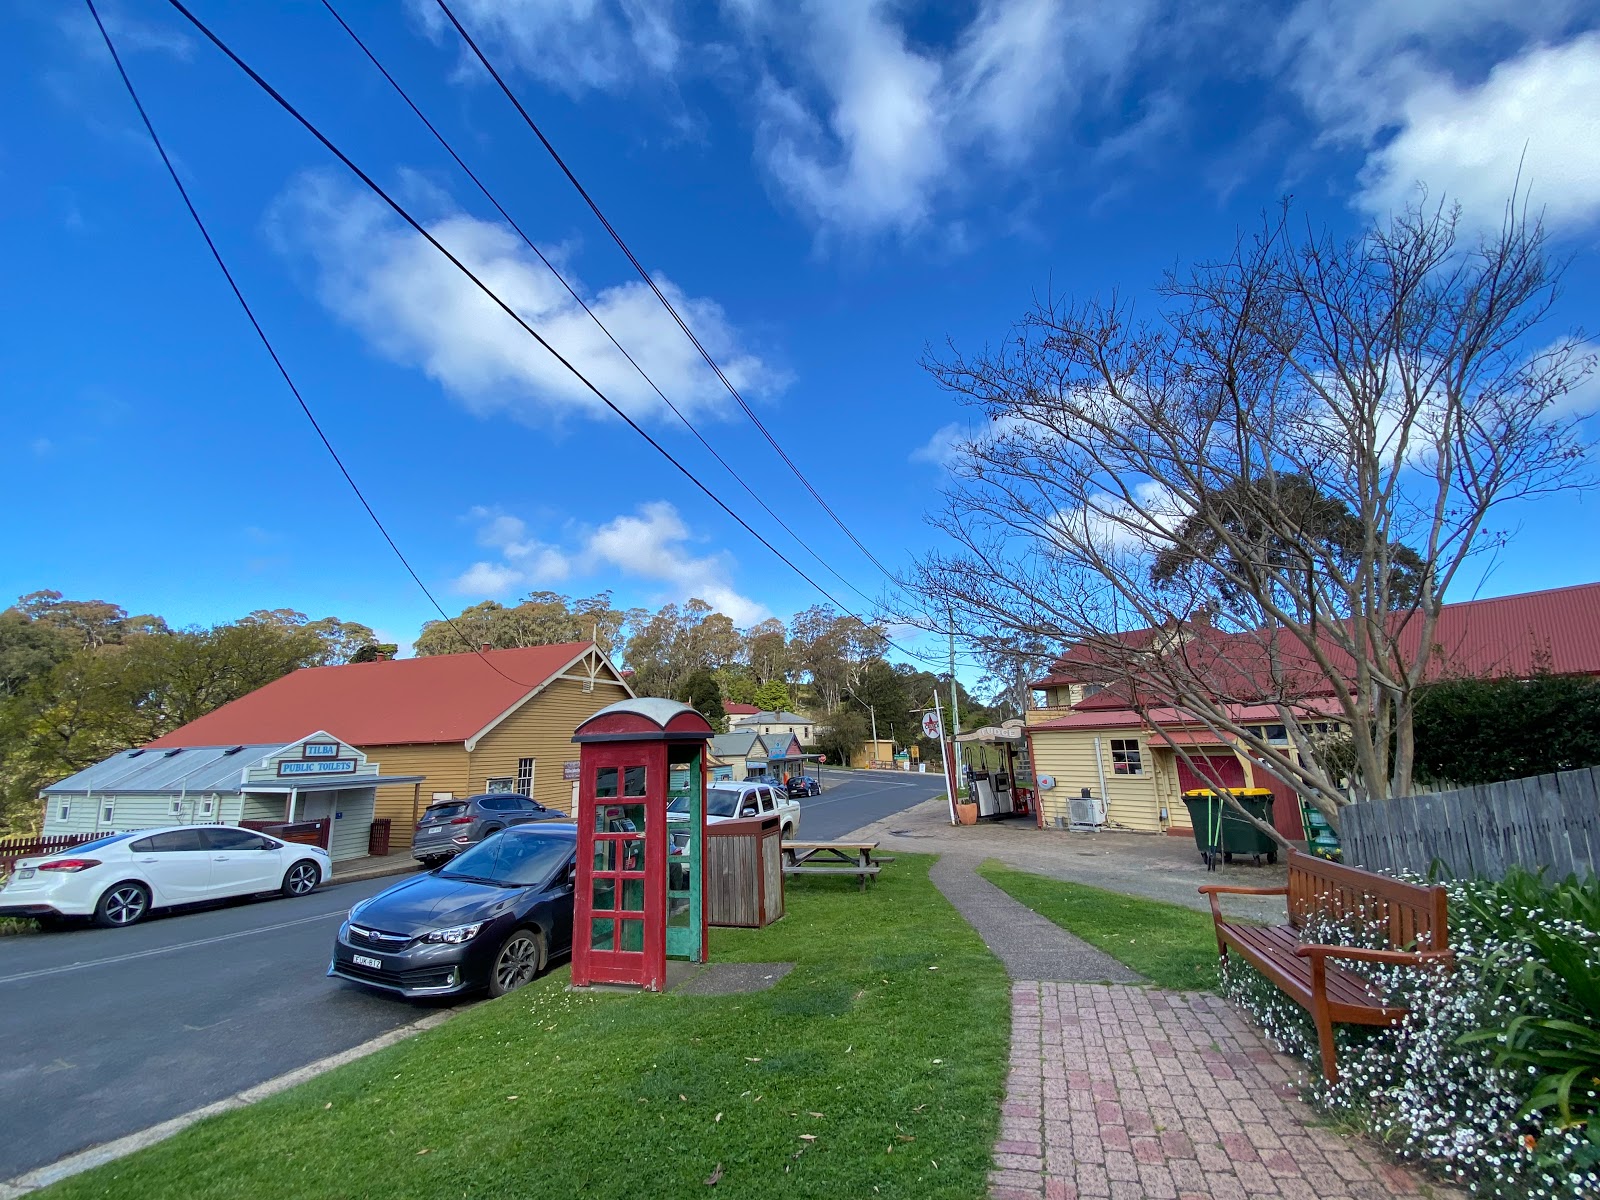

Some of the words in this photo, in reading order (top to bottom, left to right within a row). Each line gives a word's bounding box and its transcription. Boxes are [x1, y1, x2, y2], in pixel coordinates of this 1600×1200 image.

[981, 728, 1016, 737] FUDGE
[308, 746, 333, 755] TILBA
[283, 763, 314, 773] PUBLIC
[318, 762, 351, 771] TOILETS
